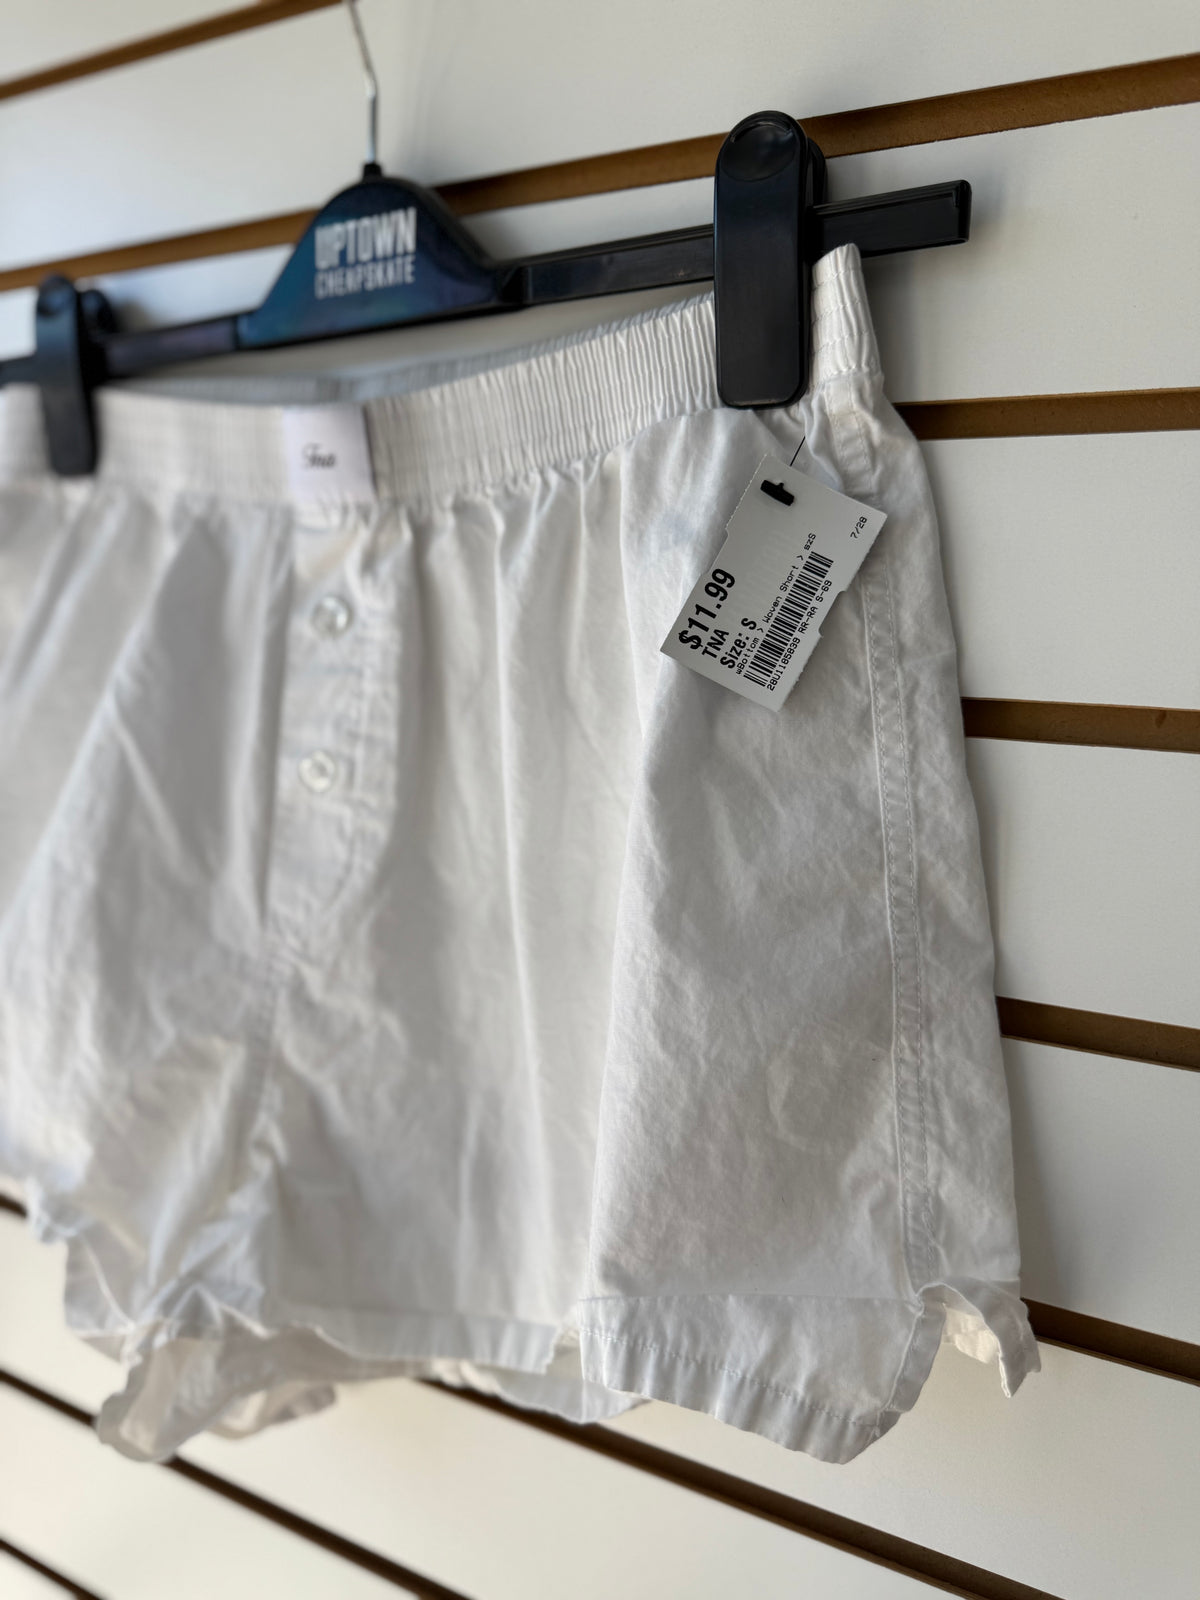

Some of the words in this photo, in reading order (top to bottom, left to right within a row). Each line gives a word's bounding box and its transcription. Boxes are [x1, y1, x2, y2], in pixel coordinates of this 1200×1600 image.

[315, 207, 417, 270] UPTOWN
[679, 569, 735, 650] $11.99
[762, 596, 782, 623] Woven
[780, 565, 799, 592] Short
[798, 606, 818, 634] RR-RA
[816, 580, 832, 602] S-69
[702, 629, 729, 658] TNA
[720, 632, 750, 669] Size:
[741, 618, 757, 630] S
